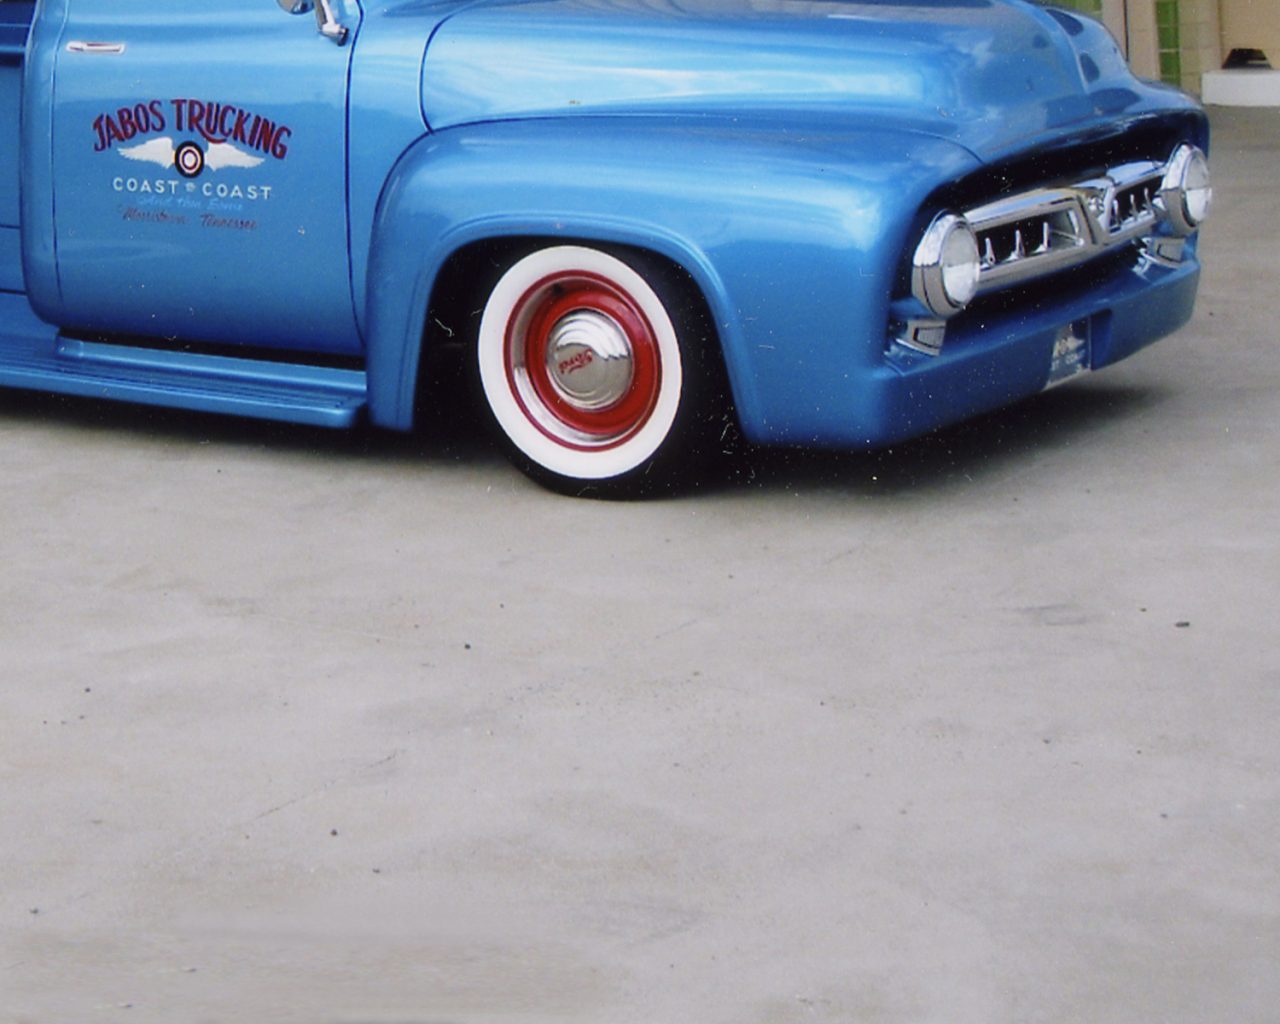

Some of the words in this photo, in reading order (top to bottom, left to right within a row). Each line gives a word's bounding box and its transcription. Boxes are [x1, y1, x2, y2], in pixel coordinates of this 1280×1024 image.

[93, 100, 166, 152] JABOS
[171, 99, 292, 159] TRUCKING
[113, 177, 179, 195] COAST
[202, 182, 272, 200] COAST
